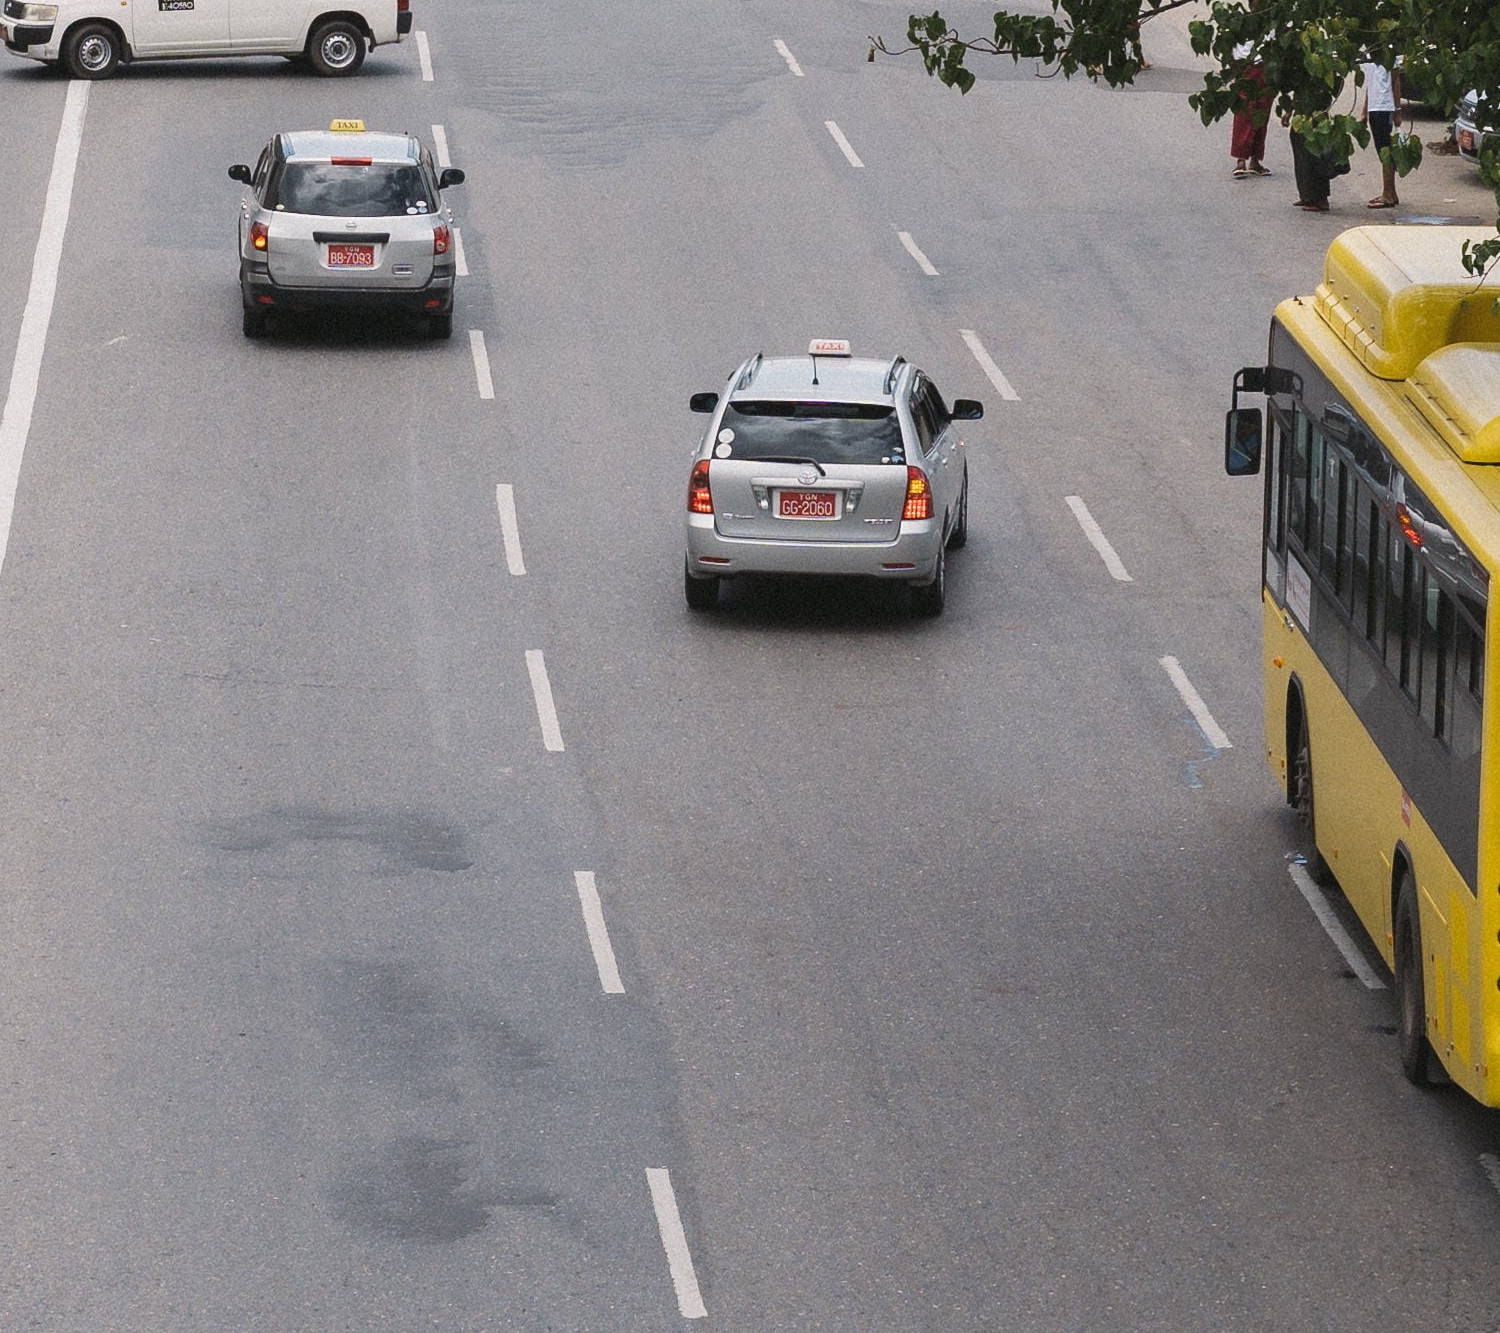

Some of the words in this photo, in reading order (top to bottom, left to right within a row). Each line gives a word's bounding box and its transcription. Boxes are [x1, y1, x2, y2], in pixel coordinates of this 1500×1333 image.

[337, 121, 359, 129] TAXI
[330, 252, 372, 265] BB-7093
[815, 342, 845, 351] TAXI
[800, 493, 818, 501] YGN
[782, 501, 833, 517] GG-2060
